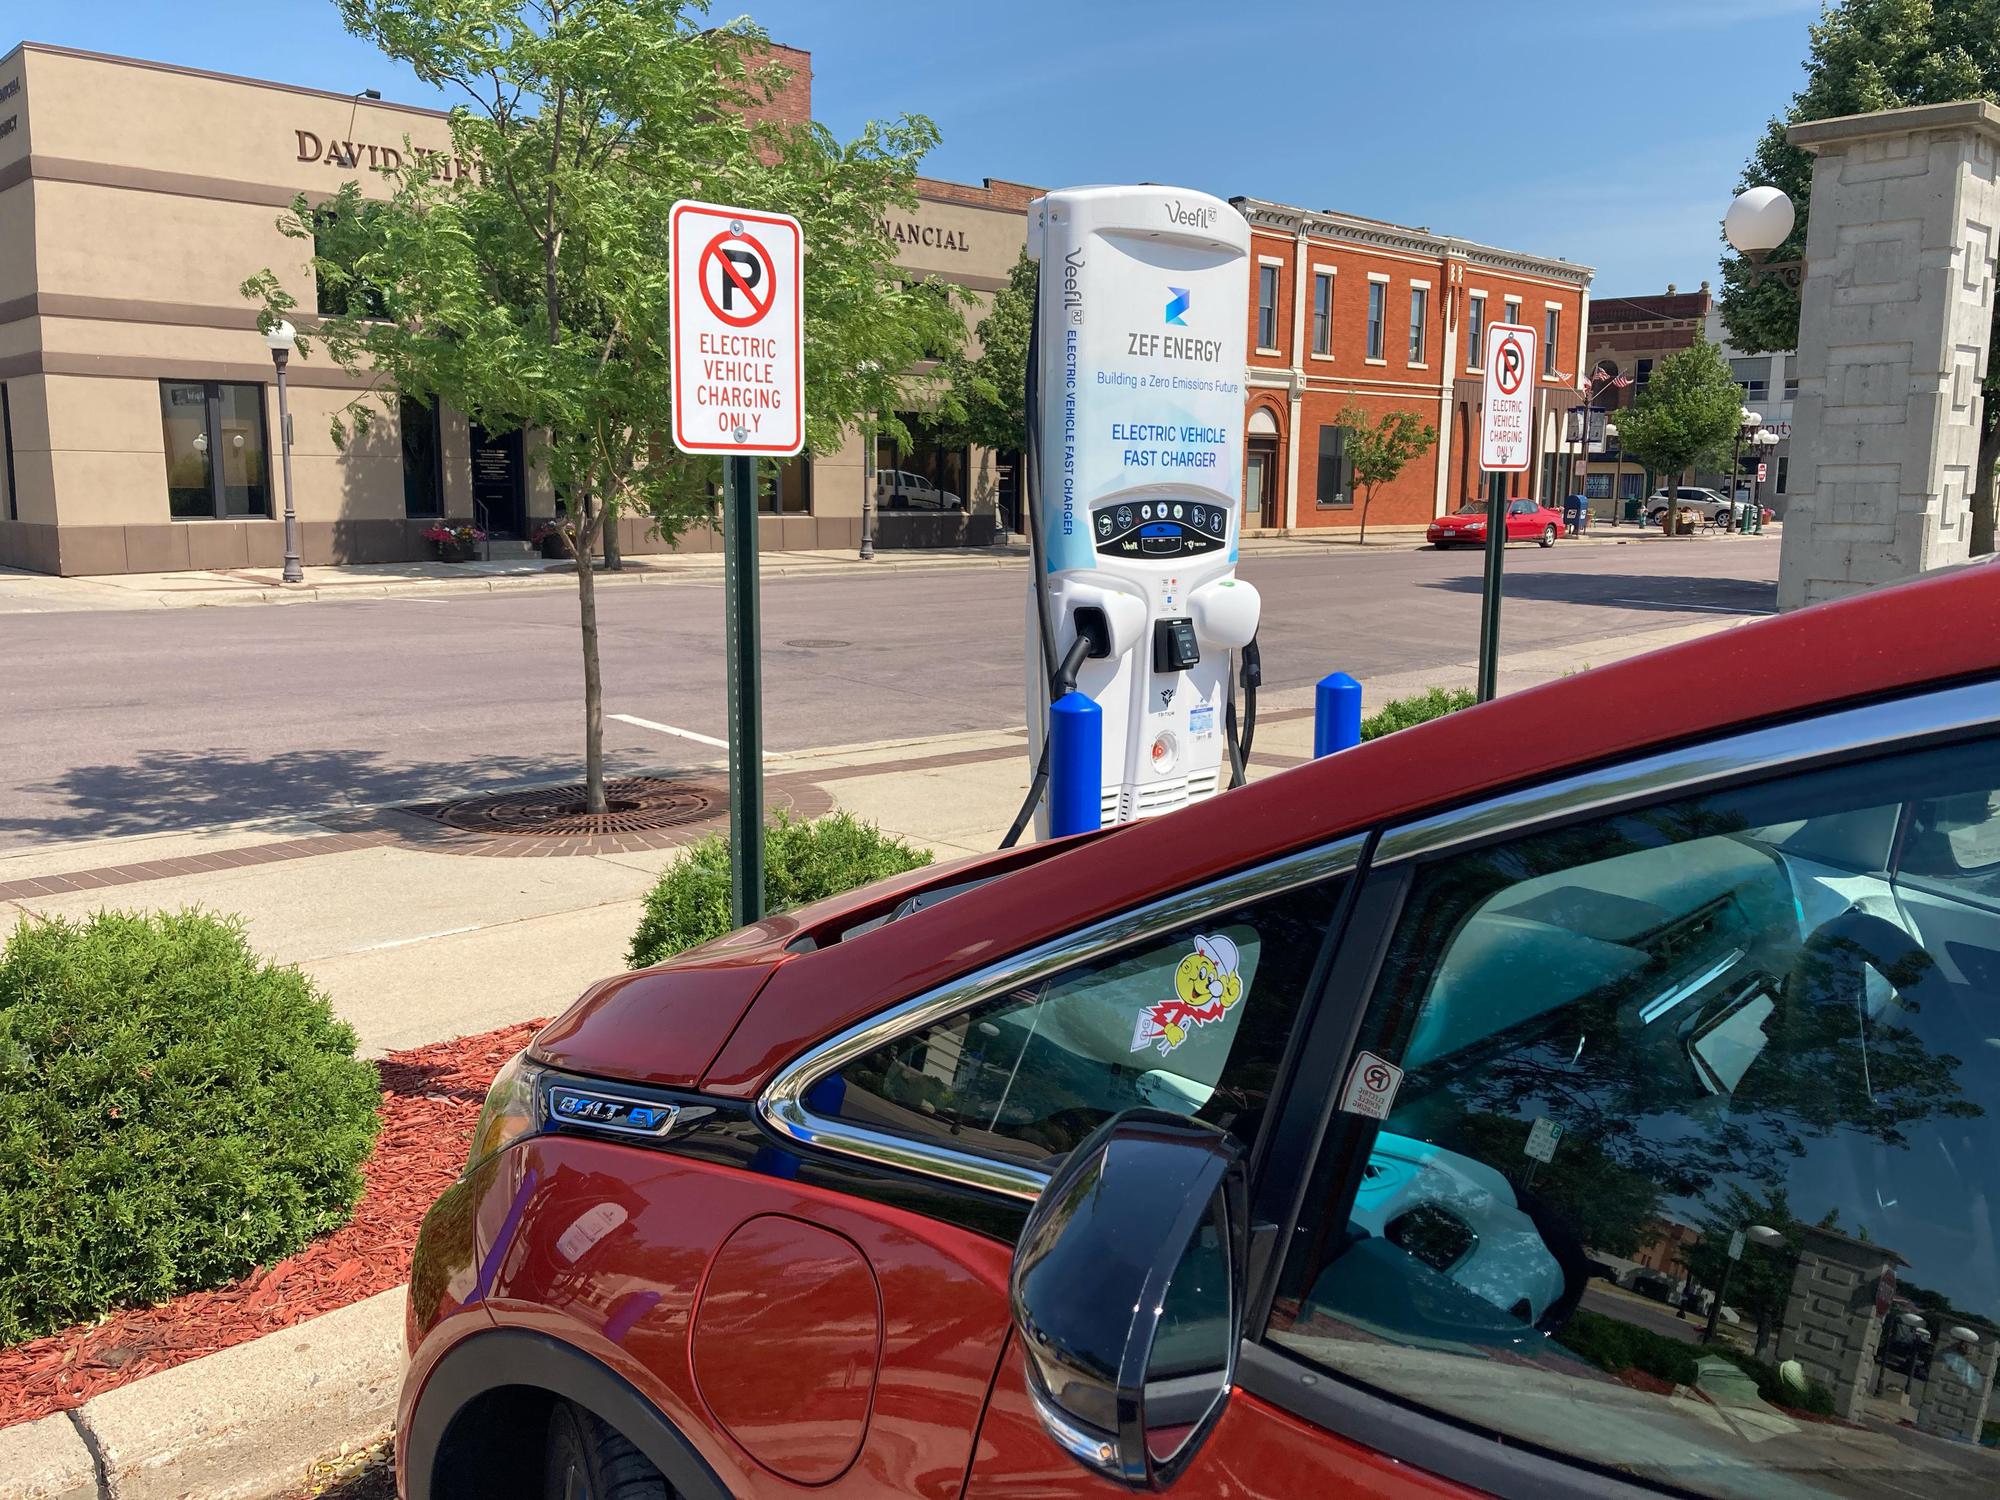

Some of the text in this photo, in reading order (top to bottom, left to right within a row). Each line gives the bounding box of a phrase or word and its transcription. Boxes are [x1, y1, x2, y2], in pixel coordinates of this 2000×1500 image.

[295, 129, 402, 172] DAVID
[878, 219, 969, 252] NANCIAL
[1165, 200, 1208, 229] Veefil
[1065, 247, 1085, 310] Veefil
[700, 333, 776, 359] ELECTRIC
[1128, 333, 1222, 363] ZEF ENERGY
[704, 359, 773, 384] VEHICLE
[1066, 330, 1077, 389] ELECTRIC
[1097, 371, 1239, 394] Building a Zero Emissions Future
[697, 385, 781, 409] CHARGING
[1492, 399, 1523, 413] ELECTRIC
[718, 412, 762, 433] ONLY
[1065, 392, 1076, 442] VEHICLE
[1493, 415, 1521, 428] VEHICLE
[1112, 424, 1226, 444] ELECTRIC VEHICLE
[1489, 430, 1522, 443] CHARGING
[1064, 446, 1074, 475] FAST
[1124, 450, 1216, 468] FAST CHARGER
[1496, 445, 1514, 458] ONLY
[1063, 479, 1074, 536] CHARGER
[627, 1107, 667, 1128] EV
